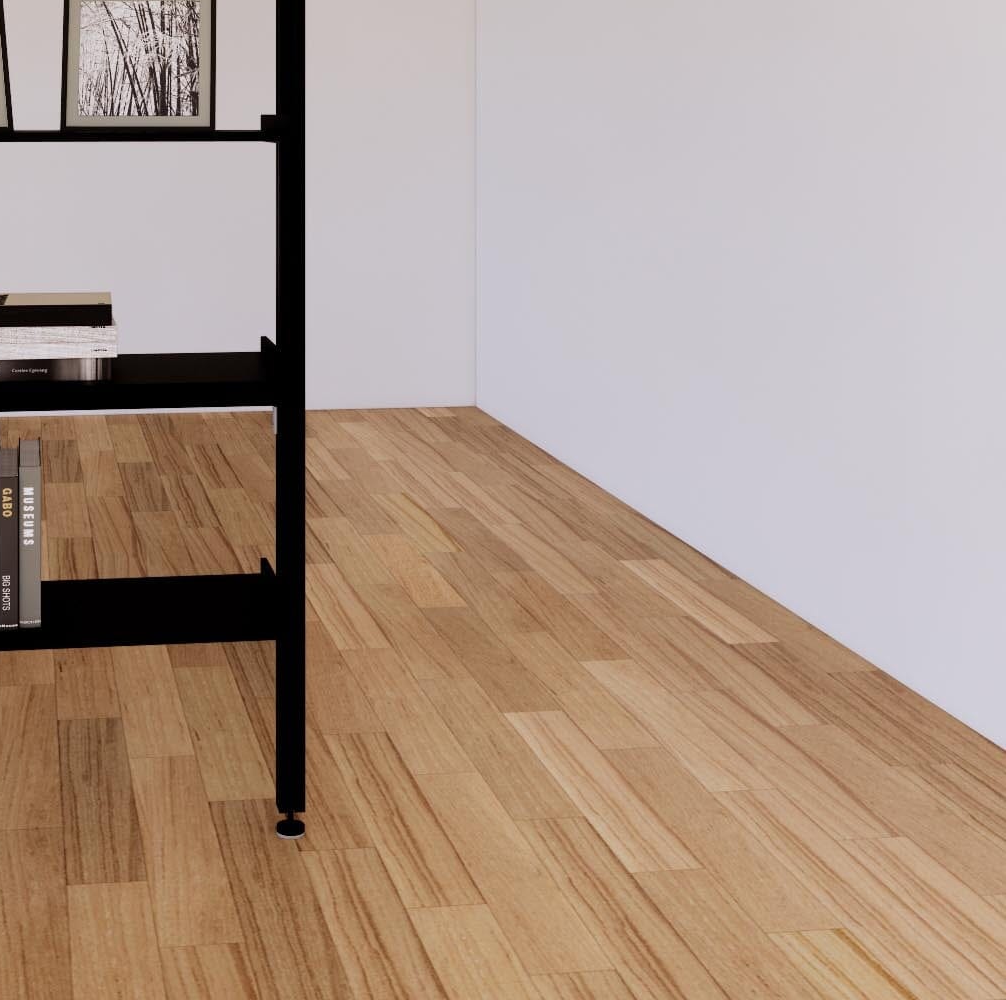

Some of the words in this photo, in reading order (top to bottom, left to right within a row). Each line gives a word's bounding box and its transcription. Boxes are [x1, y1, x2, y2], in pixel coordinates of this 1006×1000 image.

[2, 488, 12, 517] GABO
[23, 487, 34, 545] MUSEUMS
[2, 575, 10, 586] BIG
[2, 588, 10, 610] SHOTS
